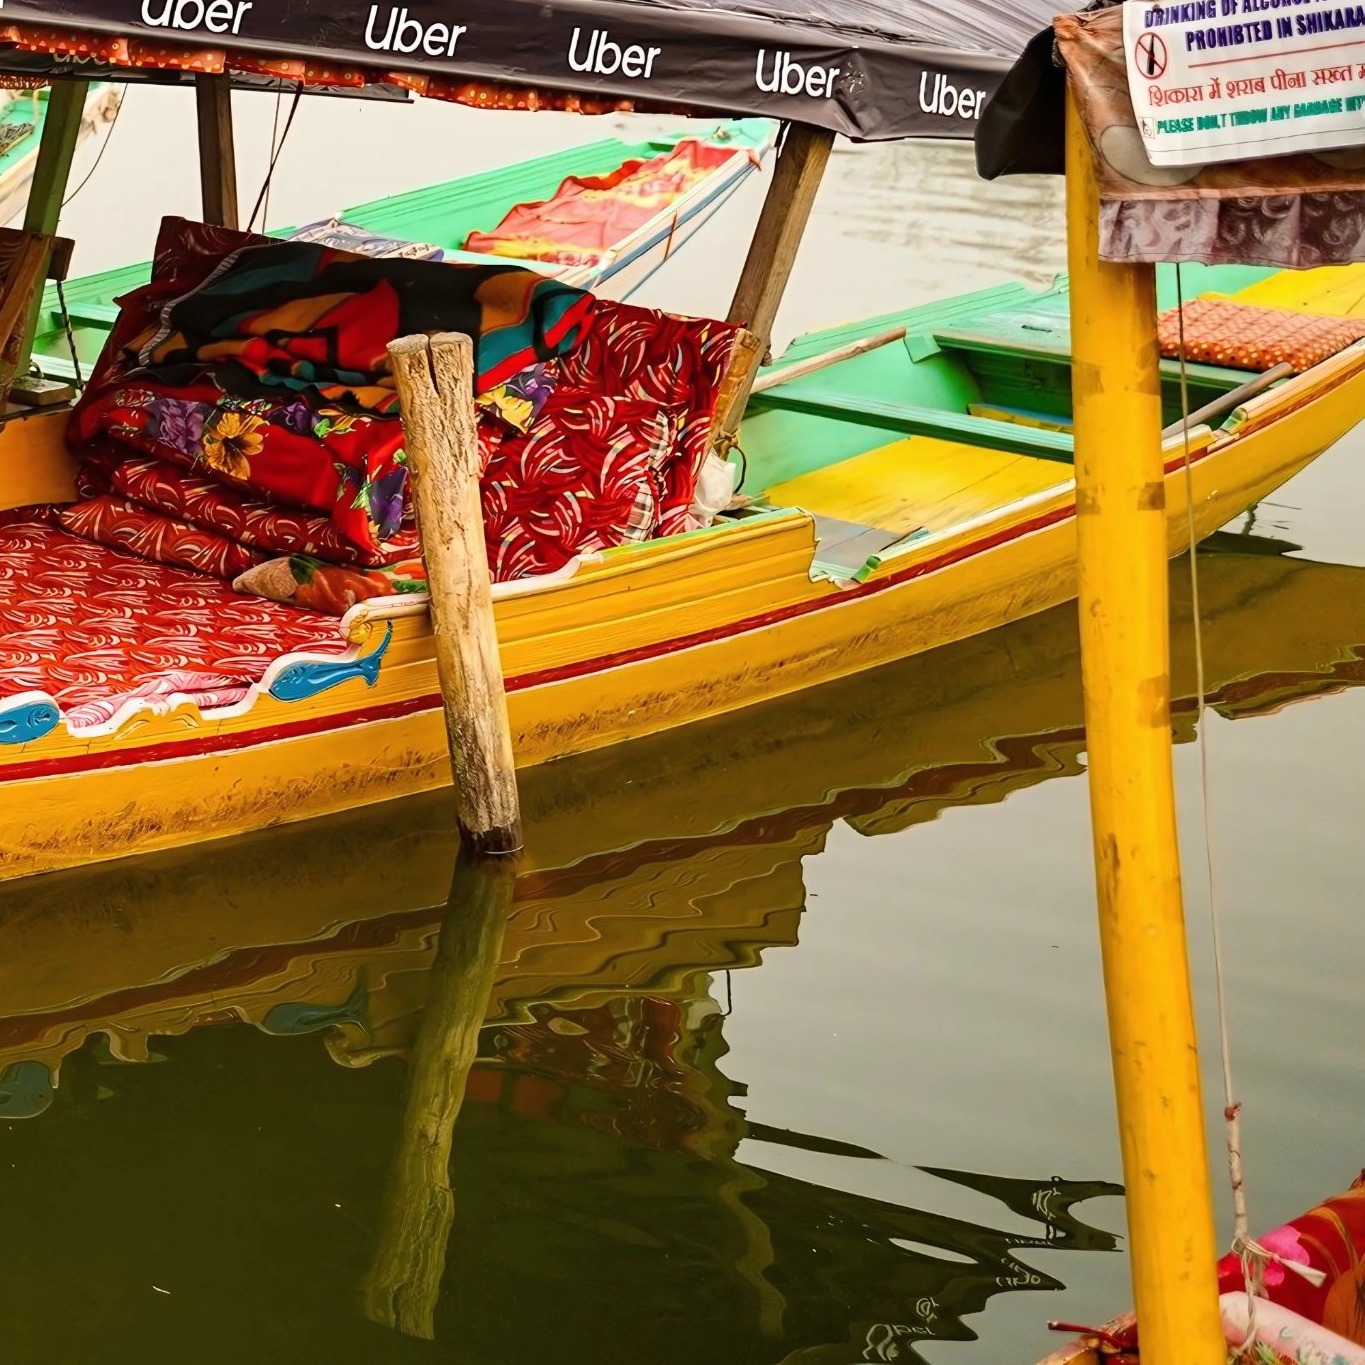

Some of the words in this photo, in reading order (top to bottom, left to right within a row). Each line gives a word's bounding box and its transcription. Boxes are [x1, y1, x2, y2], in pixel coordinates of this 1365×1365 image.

[364, 4, 467, 58] Uber
[1144, 0, 1217, 28] DRINKING
[1277, 16, 1293, 39] IN
[568, 27, 662, 79] Uber
[755, 49, 841, 98] Uber
[919, 71, 987, 120] Uber
[1148, 84, 1203, 108] शिकारा
[1208, 77, 1222, 101] में
[1226, 77, 1266, 99] शराब
[1270, 68, 1307, 91] पीना
[1157, 117, 1194, 134] PLEASE
